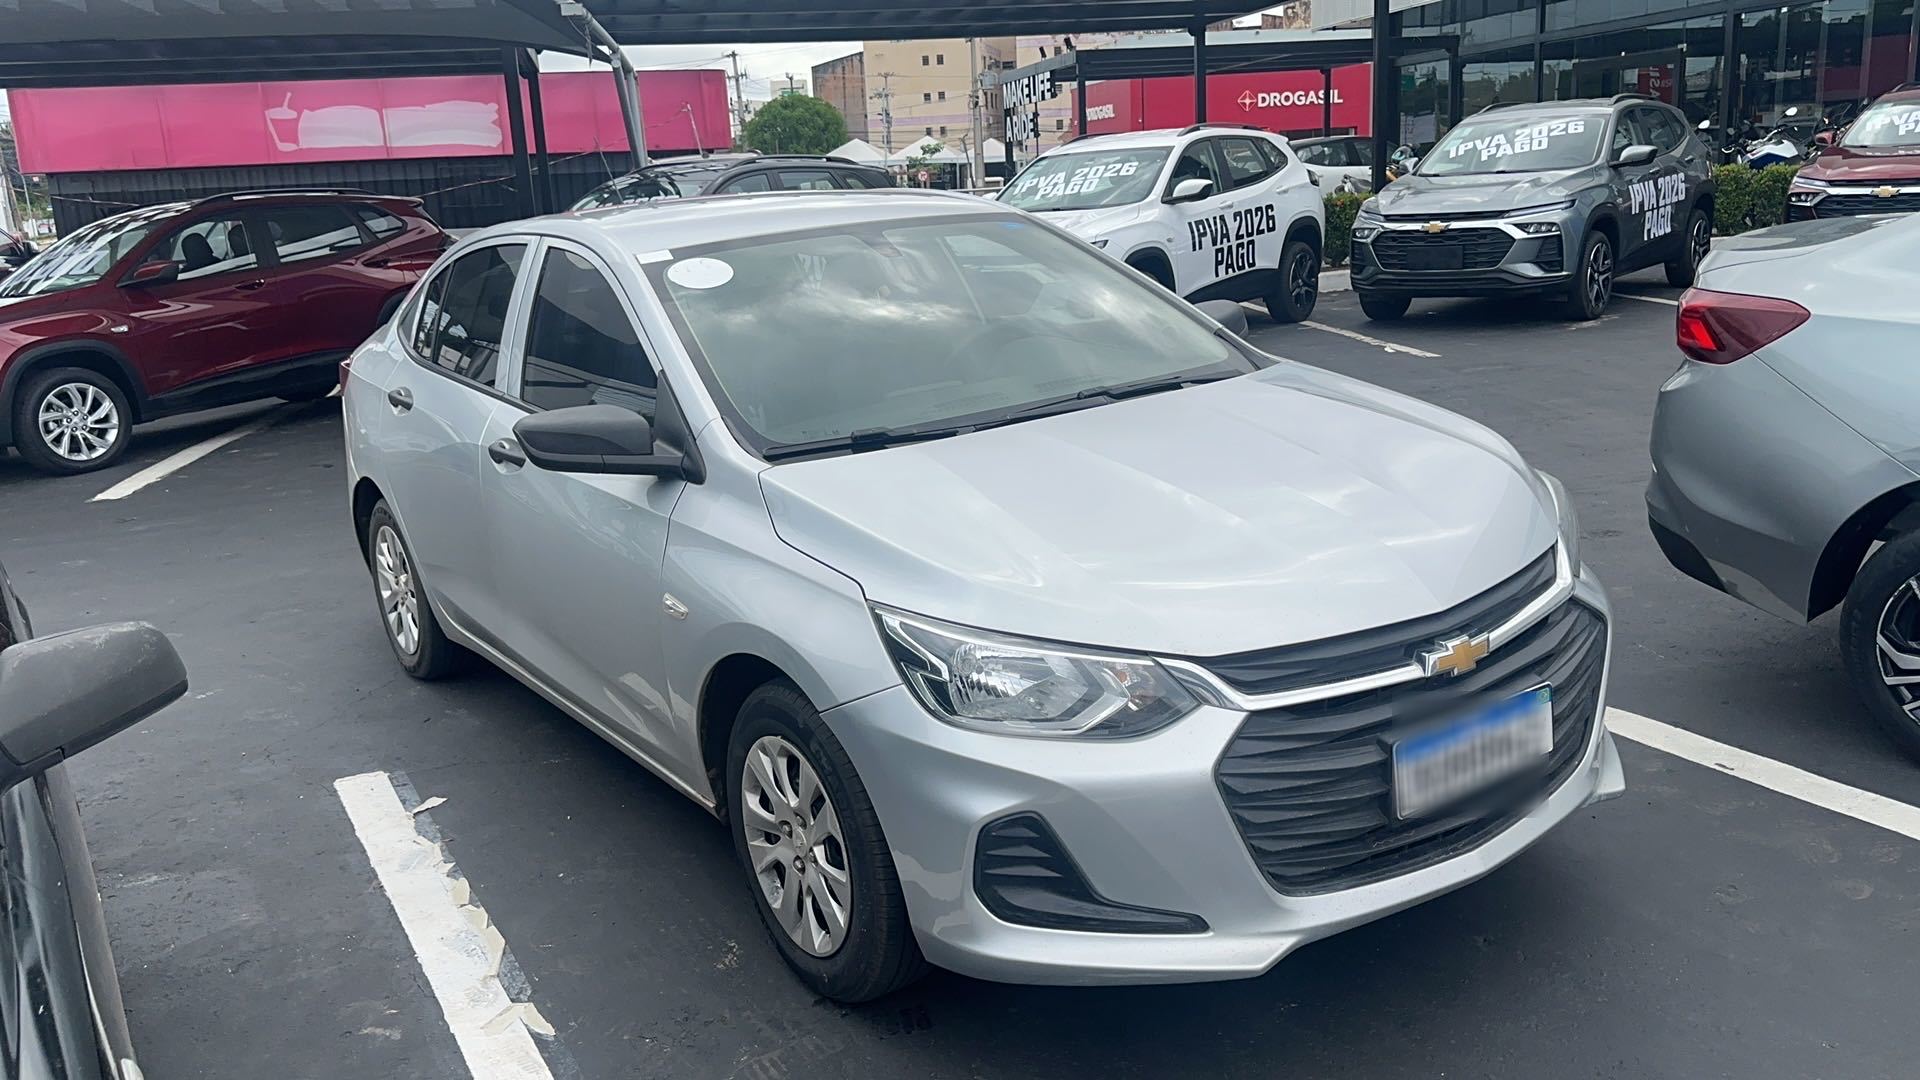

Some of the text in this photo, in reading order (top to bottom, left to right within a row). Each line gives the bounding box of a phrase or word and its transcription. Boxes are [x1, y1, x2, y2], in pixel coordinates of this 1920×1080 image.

[1003, 71, 1052, 109] MAKE LIFE
[1257, 89, 1344, 108] DROGASIL
[1006, 112, 1035, 142] A RIDE
[1449, 120, 1585, 160] IPVA 2026
[1480, 137, 1549, 162] PAGO
[1013, 161, 1139, 196] IPVA 2026
[1034, 178, 1100, 201] PAGO
[1628, 172, 1686, 215] IPVA 2026
[1187, 203, 1276, 252] IPVA 2026
[1643, 205, 1672, 241] PAGO
[1214, 238, 1256, 278] PAGO
